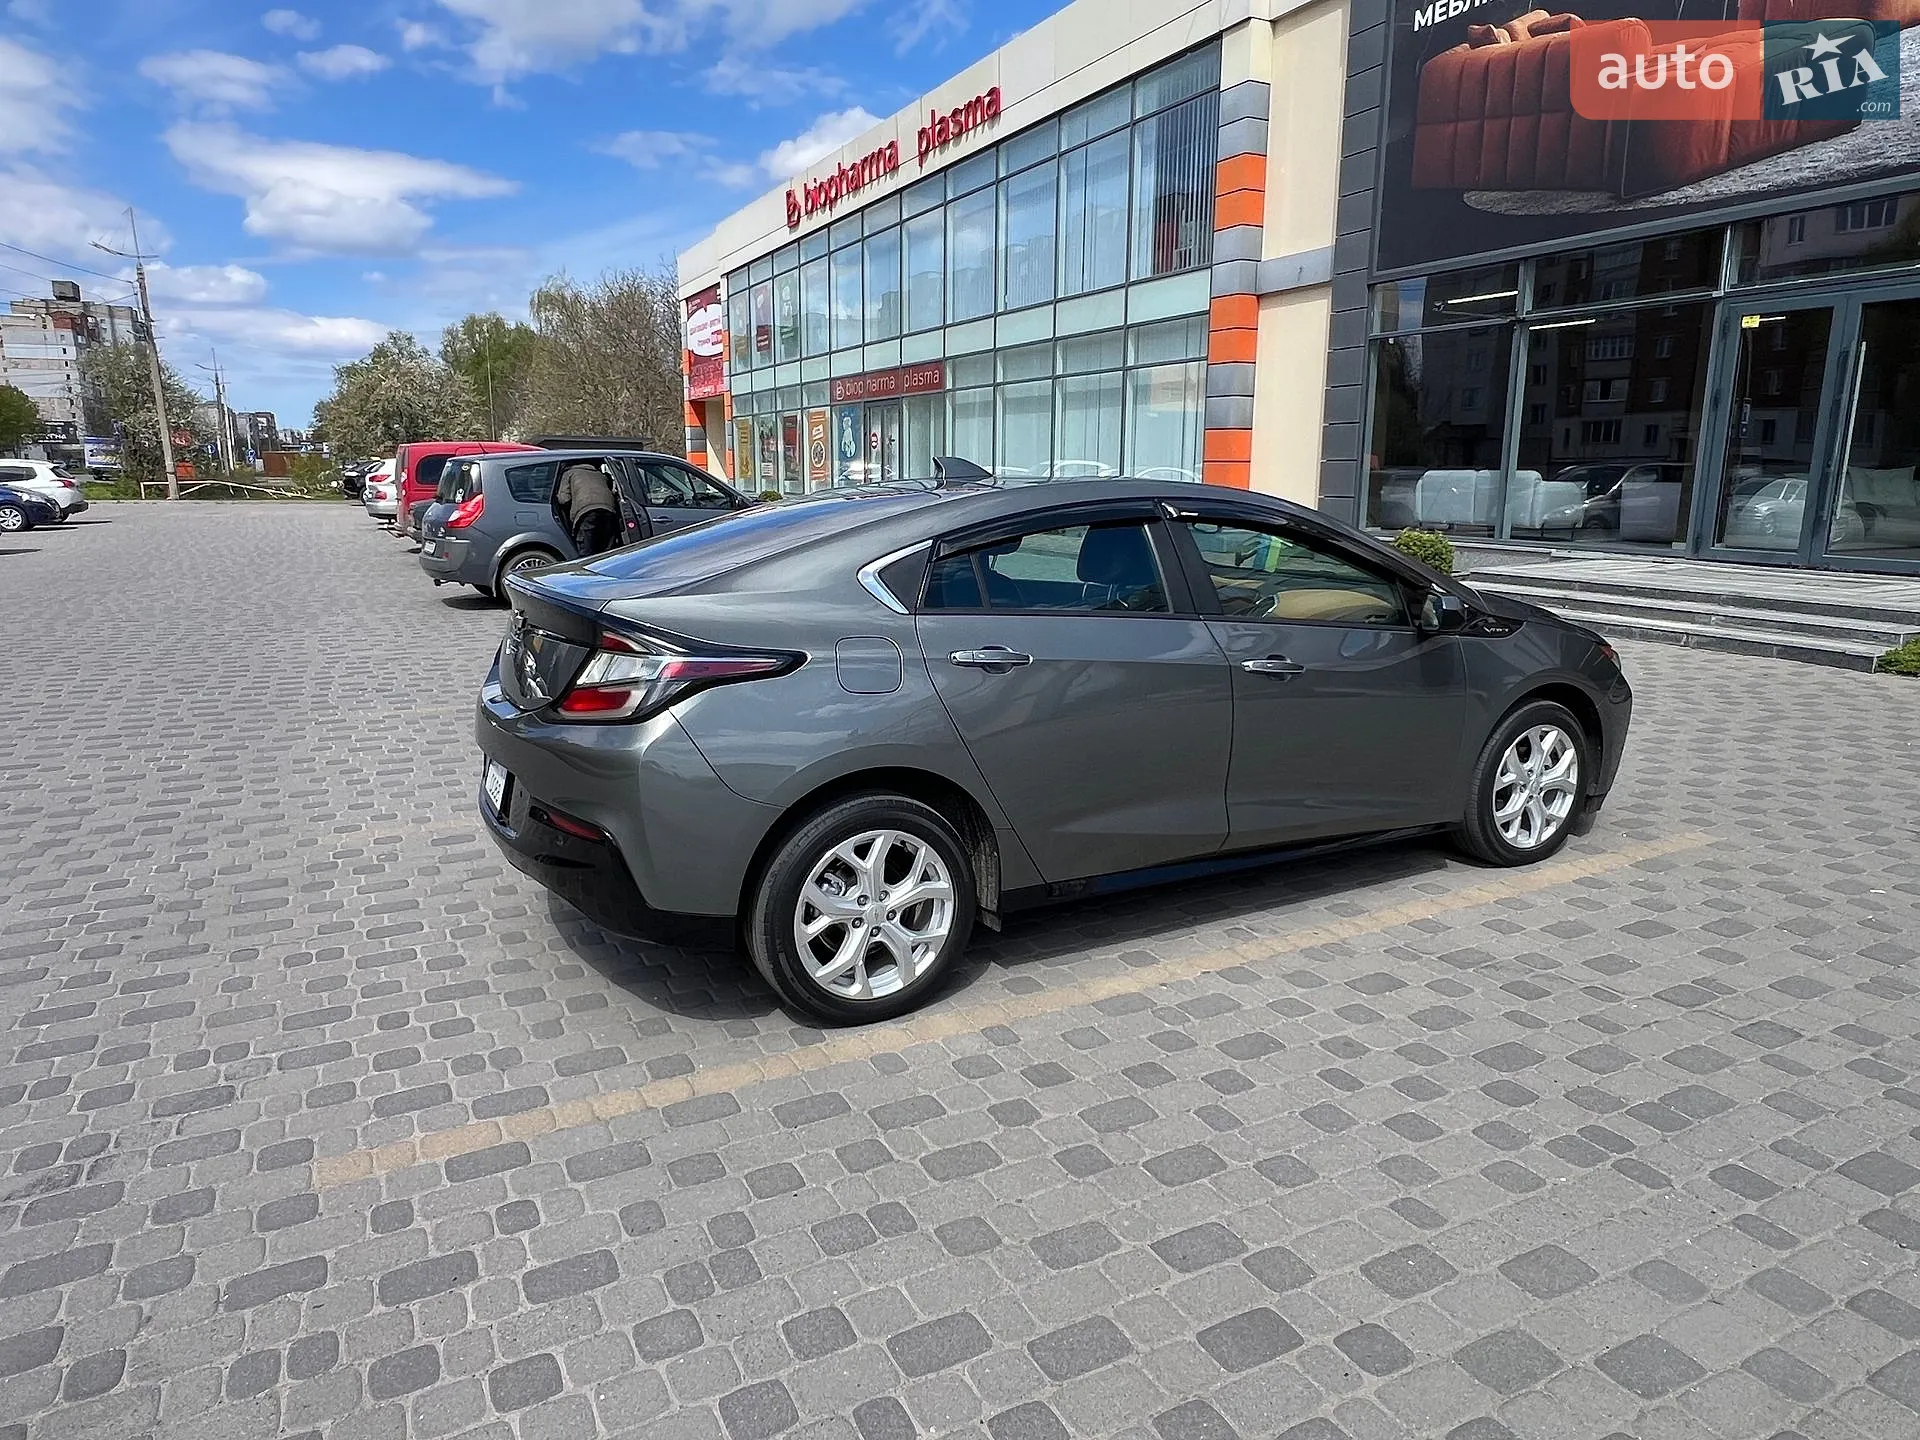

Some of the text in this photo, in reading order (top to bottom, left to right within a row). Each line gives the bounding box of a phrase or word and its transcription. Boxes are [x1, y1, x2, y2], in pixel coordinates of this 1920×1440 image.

[803, 139, 900, 216] biopharma
[917, 86, 1001, 168] plasma
[903, 369, 940, 392] plasma
